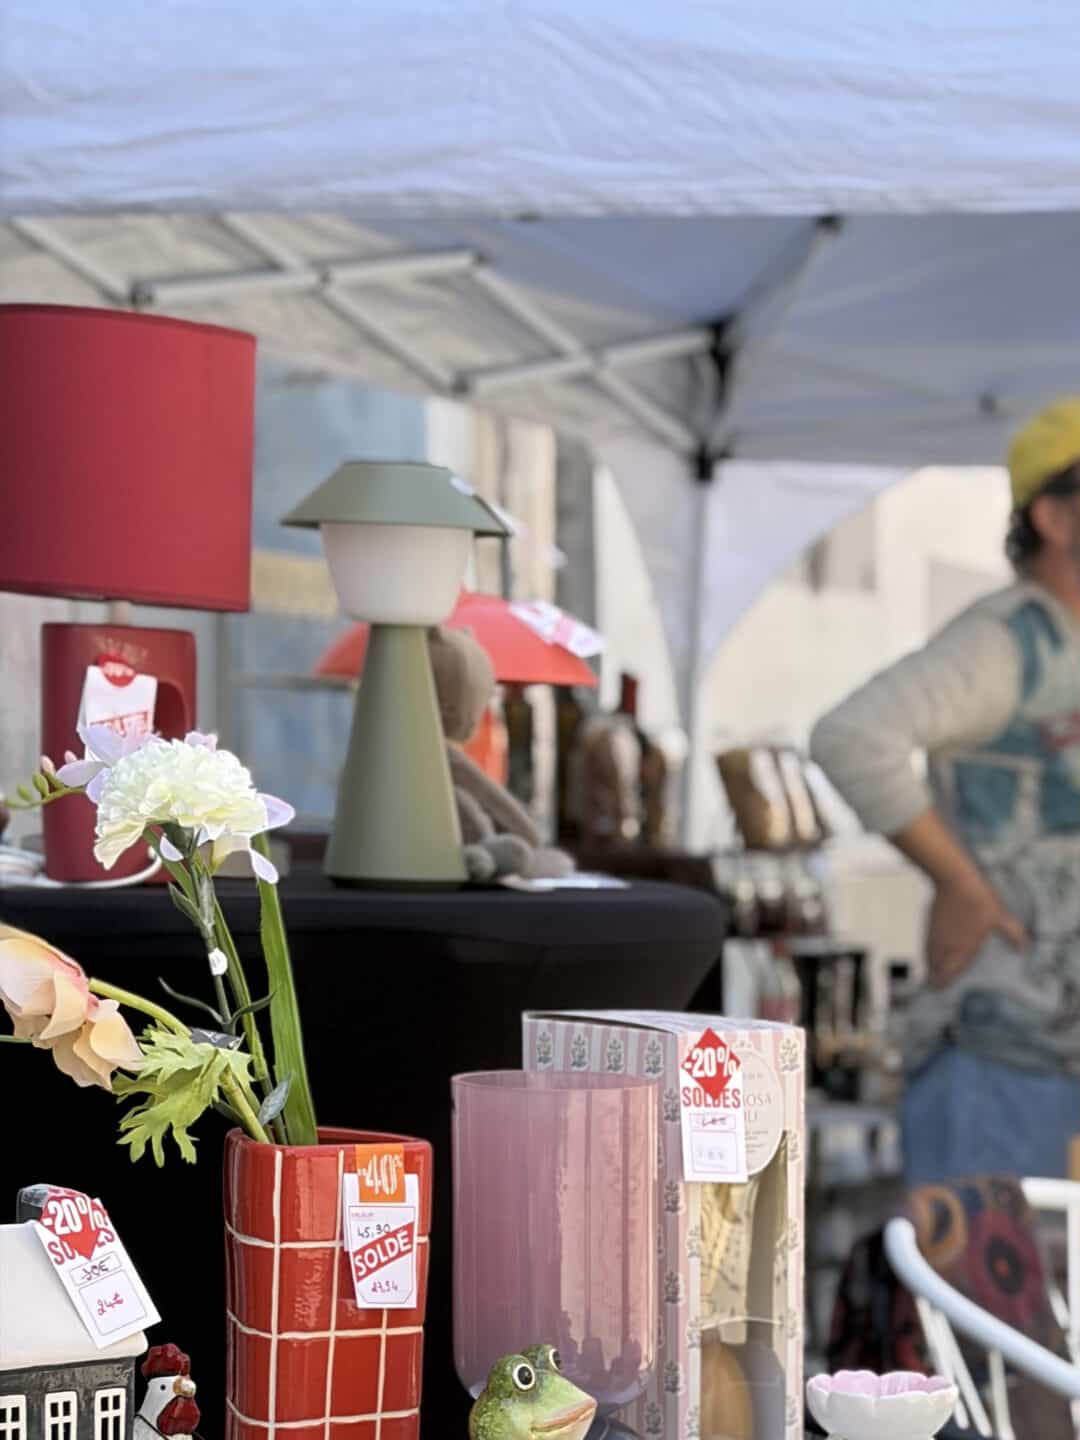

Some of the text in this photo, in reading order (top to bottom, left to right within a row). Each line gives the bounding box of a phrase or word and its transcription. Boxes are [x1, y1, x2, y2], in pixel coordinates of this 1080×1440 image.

[683, 1047, 736, 1078] -20%
[42, 1197, 107, 1236] -20%
[354, 1231, 412, 1278] SOLDE
